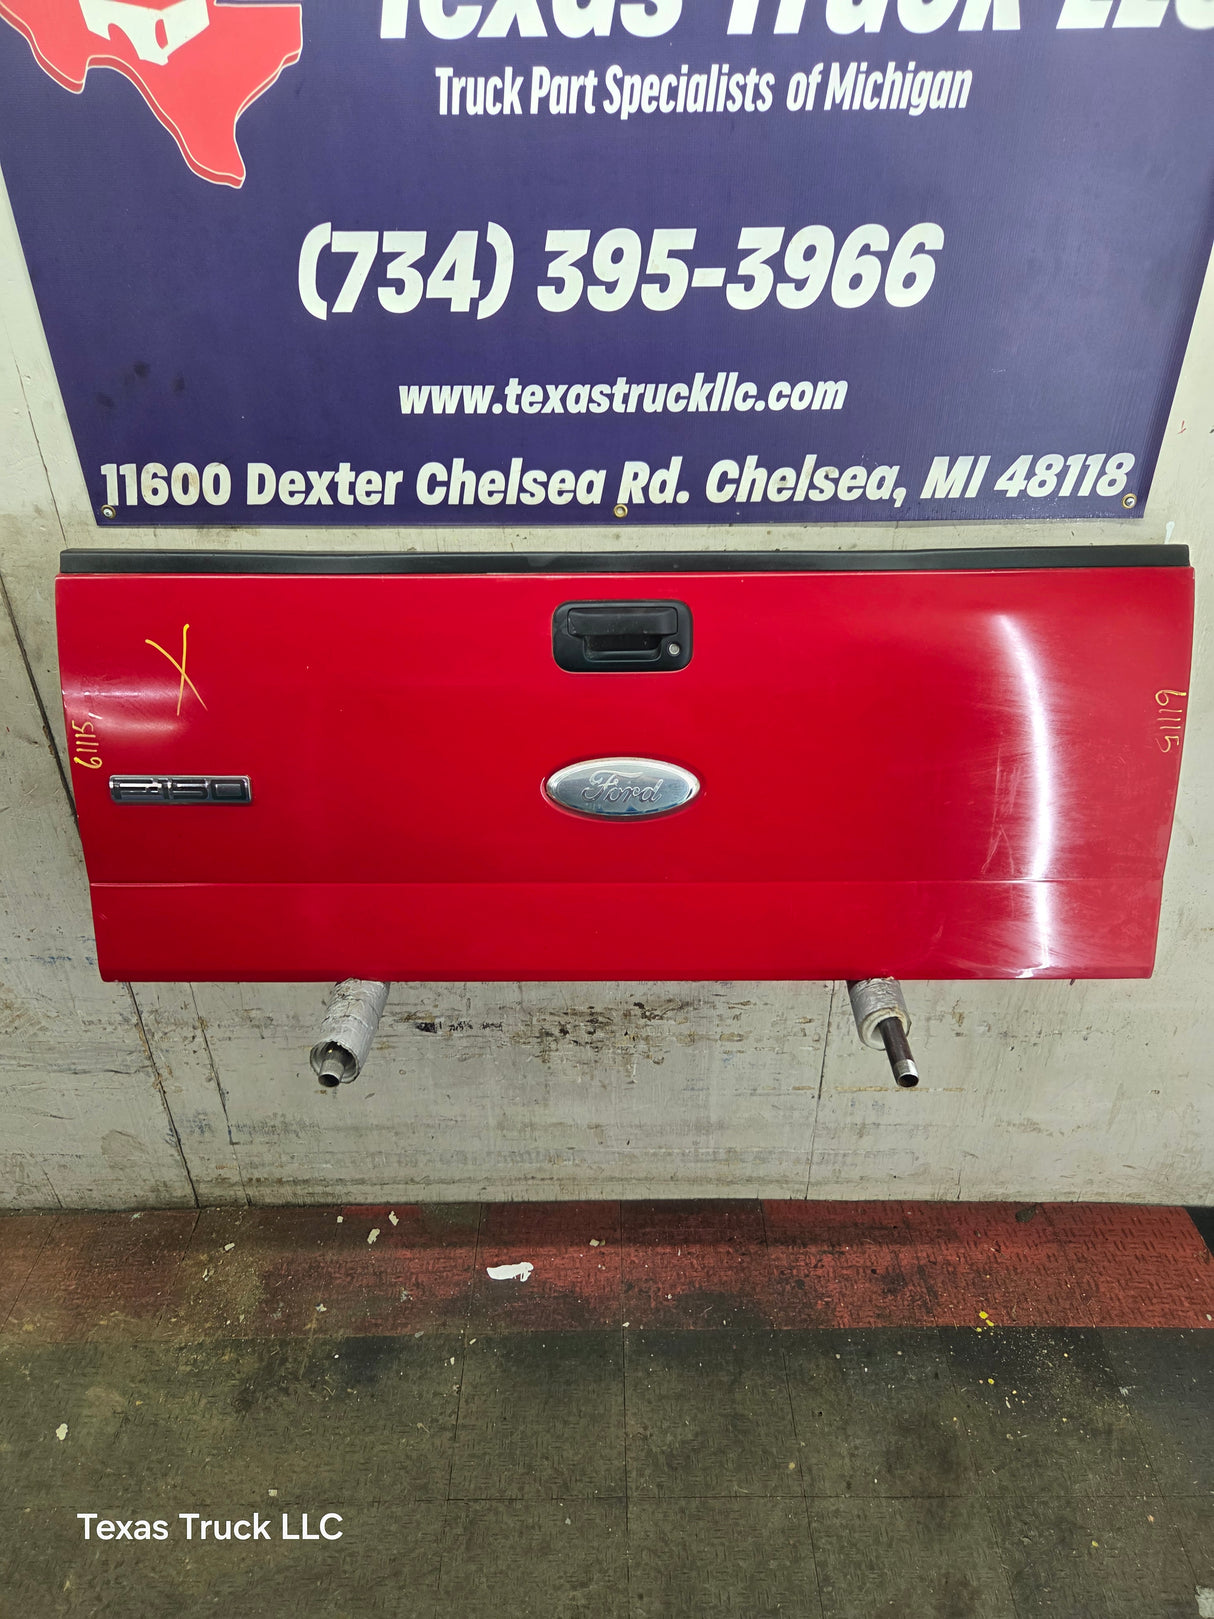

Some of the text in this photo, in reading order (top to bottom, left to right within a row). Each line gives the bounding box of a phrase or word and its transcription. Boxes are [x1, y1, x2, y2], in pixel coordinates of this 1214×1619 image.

[434, 60, 973, 121] Truck Part Specialists of Michigan
[298, 221, 945, 321] (734) 395-3966
[398, 371, 849, 415] www.texastruckllc.com
[100, 452, 1136, 508] 11600 Dexter Chelsea Rd. Chelsea, MI 48118
[581, 768, 664, 804] Ford
